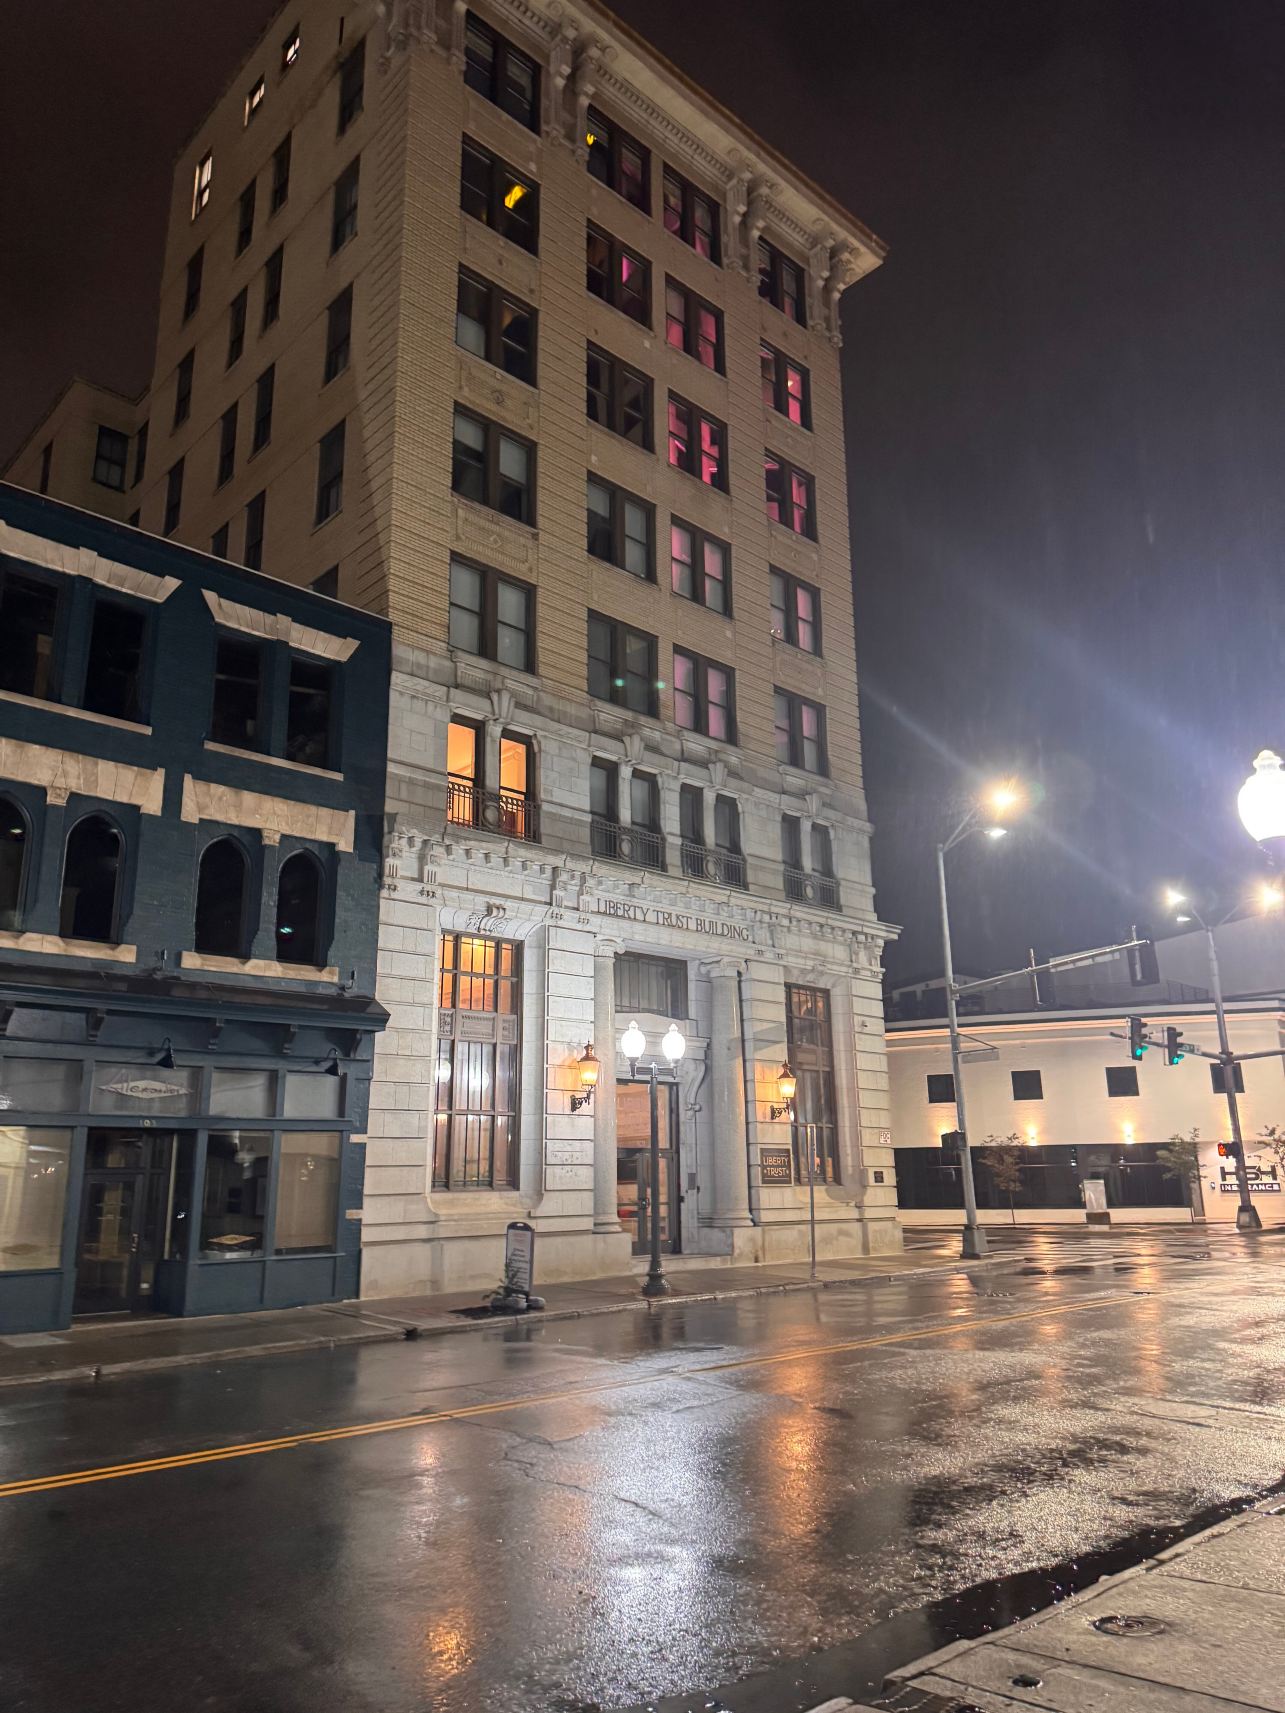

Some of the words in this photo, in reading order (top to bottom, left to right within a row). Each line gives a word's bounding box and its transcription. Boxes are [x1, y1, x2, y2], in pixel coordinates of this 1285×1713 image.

[597, 898, 650, 922] LIBERTY
[653, 909, 692, 929] TRUST
[696, 918, 749, 941] BUILDING
[763, 1156, 788, 1166] LIBERTY
[766, 1167, 787, 1177] TRUST
